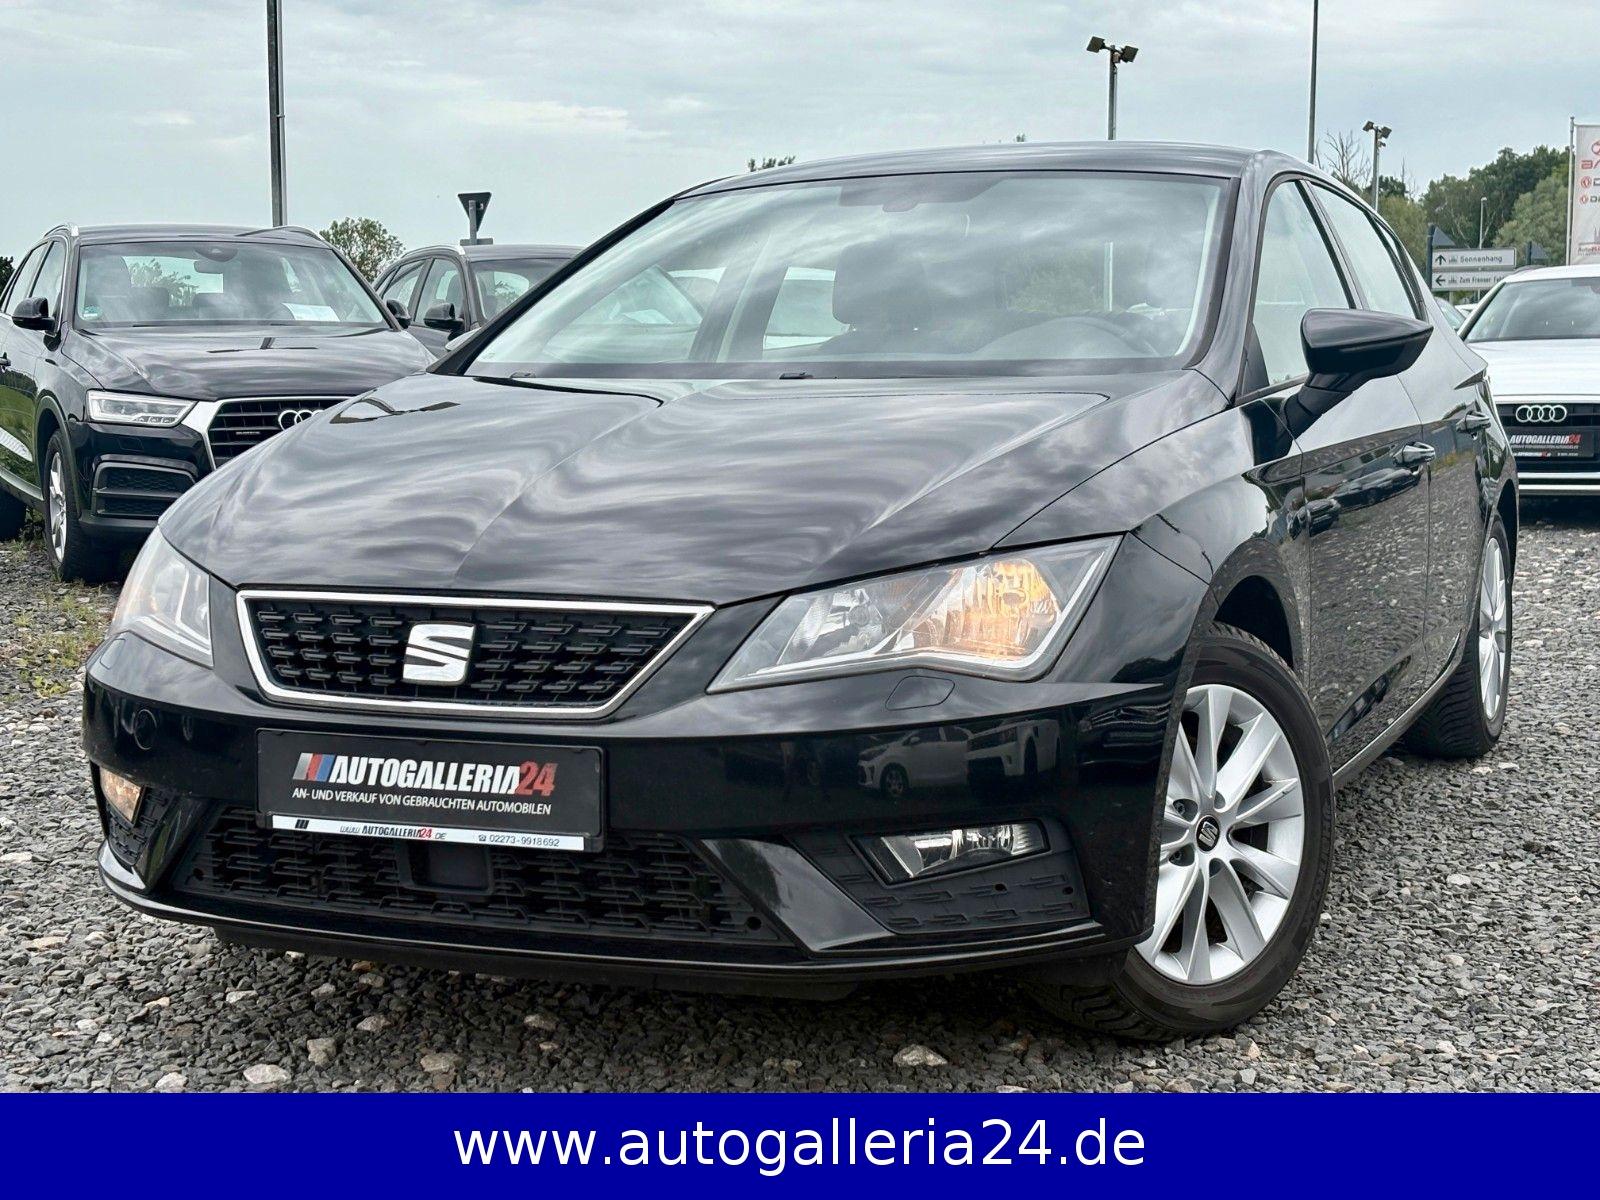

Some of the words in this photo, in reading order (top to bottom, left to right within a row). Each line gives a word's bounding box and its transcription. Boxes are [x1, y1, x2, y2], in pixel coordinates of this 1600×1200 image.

[328, 755, 558, 797] AUTOGALLERIA24
[292, 787, 311, 799] AN-
[311, 788, 334, 801] UND
[335, 790, 378, 804] VERKAUF
[379, 793, 402, 806] VON
[402, 794, 475, 811] GEBRAUCHTEN
[476, 800, 552, 816] AUTOMOBILEN
